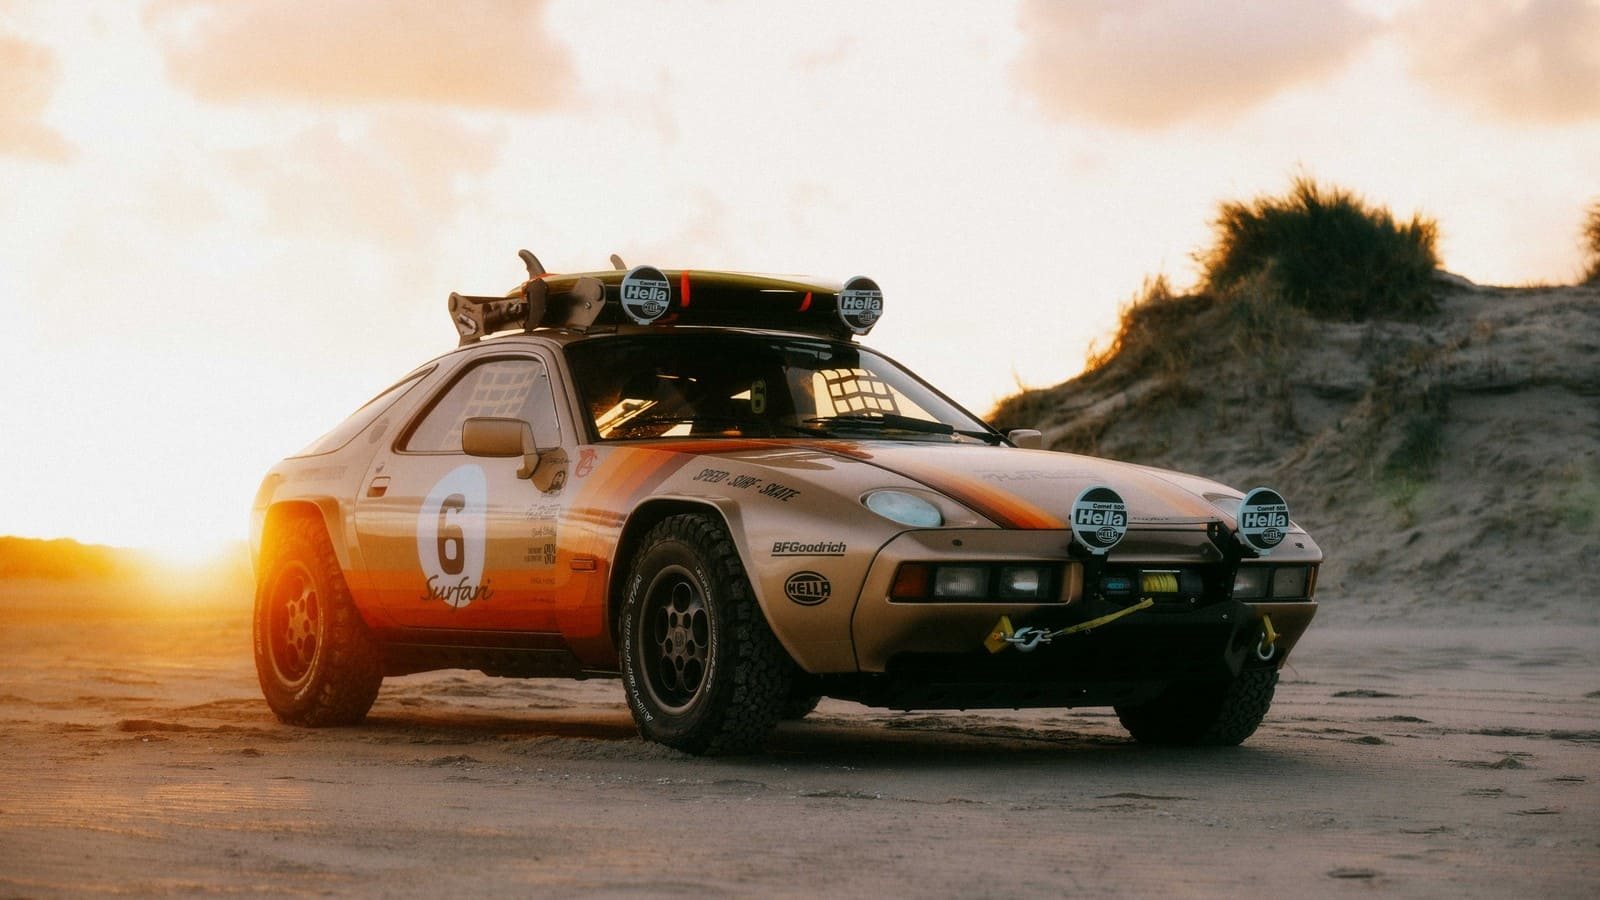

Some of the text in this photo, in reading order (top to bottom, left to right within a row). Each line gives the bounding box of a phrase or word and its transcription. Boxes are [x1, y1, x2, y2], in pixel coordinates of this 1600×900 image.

[626, 286, 667, 301] Hella
[843, 297, 881, 310] Hella
[693, 468, 801, 501] SPEED SURF SKATE
[1078, 510, 1124, 526] Hella
[1244, 512, 1286, 527] Hella
[437, 493, 466, 575] 6
[772, 541, 847, 553] BFGoodrich
[420, 574, 494, 610] Surfari
[787, 581, 831, 597] HELLA
